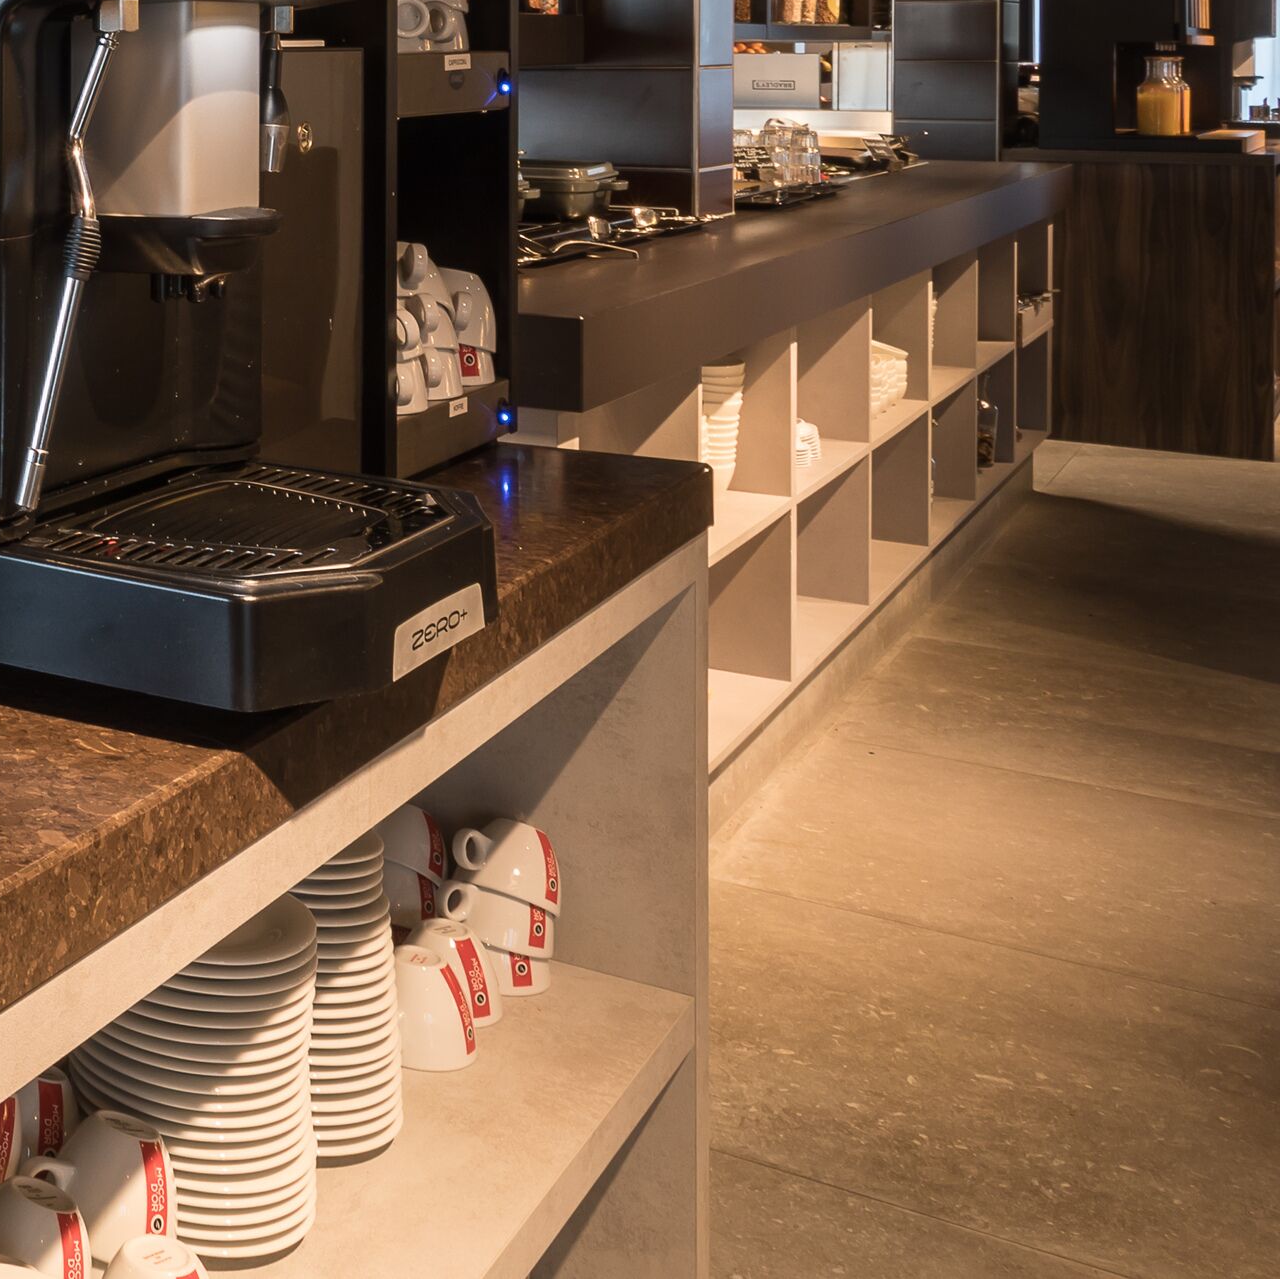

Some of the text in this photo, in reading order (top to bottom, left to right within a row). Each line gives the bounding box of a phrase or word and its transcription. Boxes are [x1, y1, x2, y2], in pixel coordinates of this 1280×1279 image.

[471, 958, 484, 991] MOCCA
[52, 1104, 60, 1144] MOCCA
[151, 1183, 159, 1212] D'OR
[155, 1167, 165, 1212] MOCCA
[68, 1258, 76, 1279] D'O
[73, 1240, 81, 1279] MOCC
